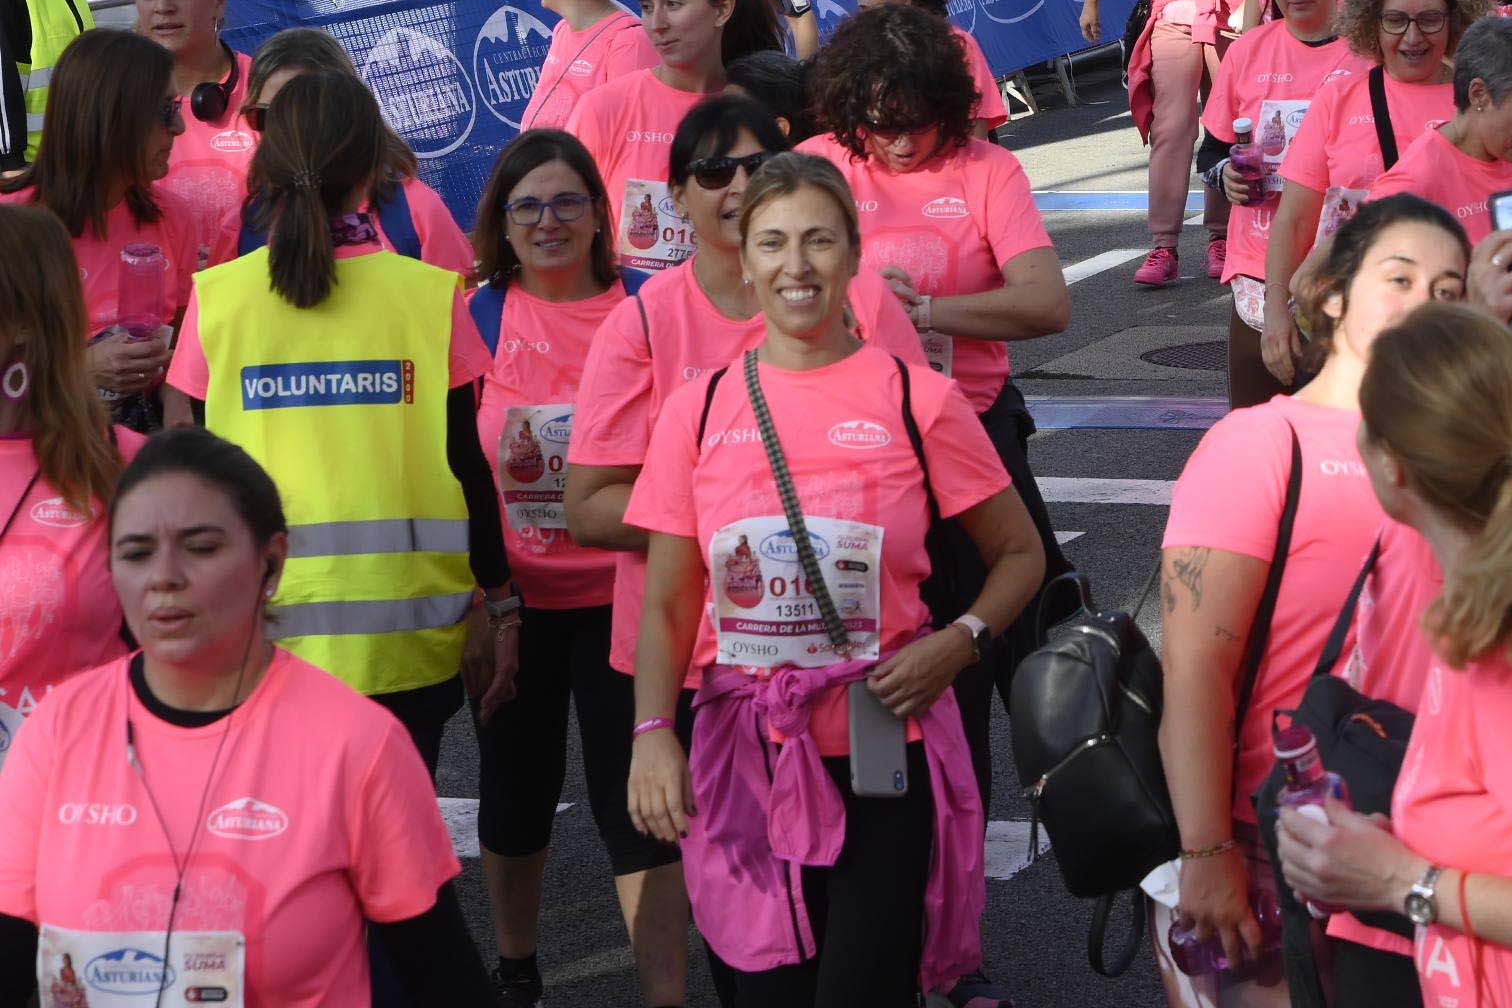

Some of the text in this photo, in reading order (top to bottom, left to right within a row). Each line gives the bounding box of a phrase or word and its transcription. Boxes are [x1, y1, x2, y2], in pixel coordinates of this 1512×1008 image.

[1256, 72, 1294, 84] OYSHO
[385, 81, 472, 129] STURIANA
[626, 130, 674, 143] OYSHO
[632, 258, 664, 268] CARRERA
[244, 372, 398, 398] VOLUNTARIS
[834, 431, 887, 443] ASTURIANA
[516, 509, 556, 520] OYSHO
[836, 541, 868, 550] SUMA
[776, 604, 814, 617] 13511
[736, 622, 806, 634] CARRERA DE LA
[733, 641, 778, 657] OYSHO
[58, 802, 138, 826] OYSHO
[216, 816, 282, 830] ASTURIANA
